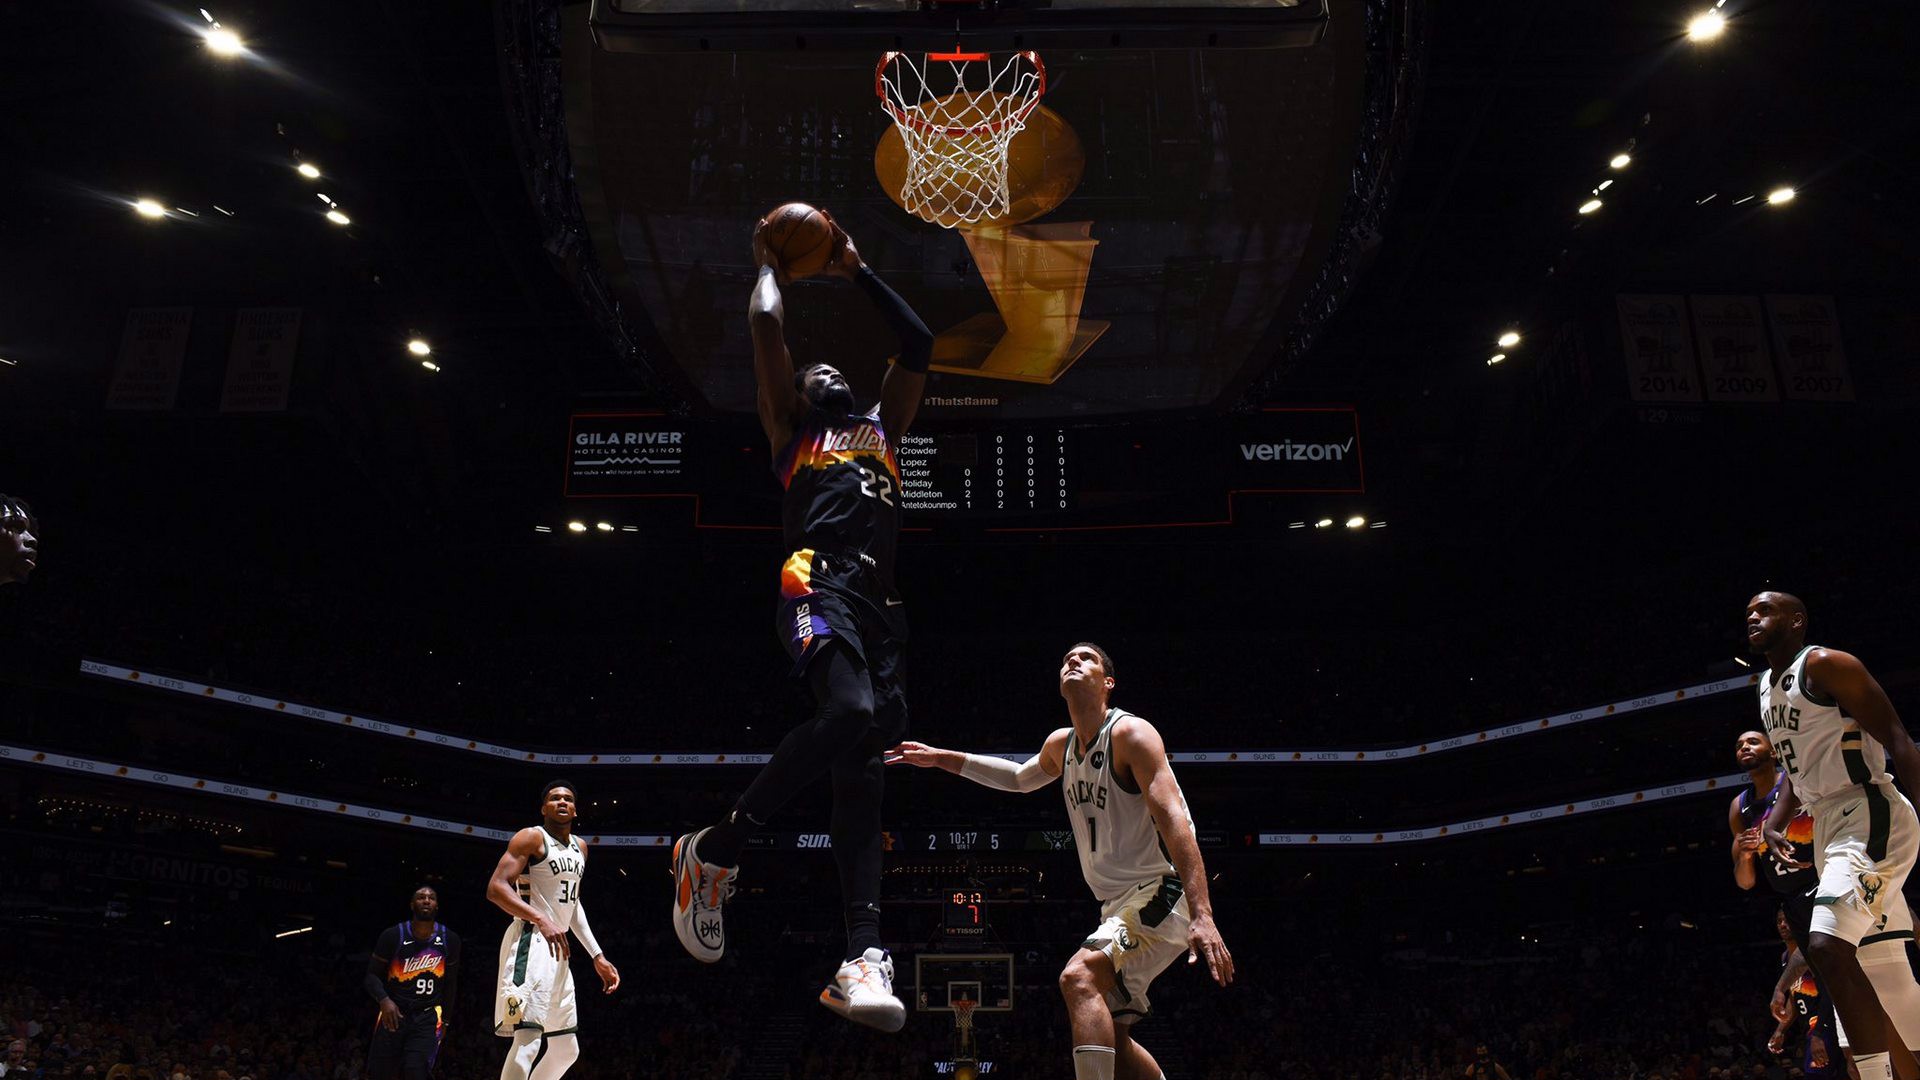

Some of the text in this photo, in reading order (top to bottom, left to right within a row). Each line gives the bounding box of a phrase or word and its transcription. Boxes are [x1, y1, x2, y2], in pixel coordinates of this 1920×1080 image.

[1640, 377, 1690, 393] 2014
[1715, 377, 1767, 393] 2009
[1793, 376, 1843, 392] 2007
[924, 397, 999, 406] #ThatsGame
[576, 432, 682, 445] GILA RIVER
[822, 424, 888, 458] Valley
[901, 435, 1064, 445] Bridges 0 0 0
[901, 447, 938, 455] Crowder
[996, 446, 1003, 454] 0
[1027, 446, 1034, 454] 0
[1240, 438, 1343, 461] verizon
[901, 458, 927, 467] Lopez
[997, 458, 1003, 466] 0
[1058, 457, 1065, 465] 0
[901, 469, 930, 477] Tucker
[964, 468, 971, 477] 0
[997, 468, 1003, 476] 0
[1028, 468, 1034, 476] 0
[859, 467, 894, 507] 22
[901, 479, 933, 488] Holiday
[965, 479, 971, 487] 0
[997, 479, 1003, 487] 0
[1028, 479, 1034, 487] 0
[900, 490, 943, 498] Middleton
[965, 490, 971, 498] 2
[1060, 489, 1066, 497] 0
[1060, 500, 1066, 508] 0
[796, 602, 814, 639] SUNS
[1764, 704, 1801, 733] UCKS
[1194, 753, 1207, 761] GO
[1569, 712, 1583, 722] GO
[435, 735, 448, 744] GO
[618, 755, 632, 763] GO
[677, 755, 700, 763] SUNS
[1774, 738, 1799, 775] 22
[152, 773, 169, 783] GO
[367, 809, 381, 818] GO
[1530, 811, 1543, 819] GO
[928, 832, 999, 850] 2 10:17 5
[1088, 817, 1096, 852] 1
[549, 857, 585, 878] BUCKS
[559, 880, 578, 904] 34
[968, 905, 978, 923] 7
[403, 954, 442, 973] Valley
[416, 979, 434, 996] 99
[1797, 999, 1808, 1015] 3
